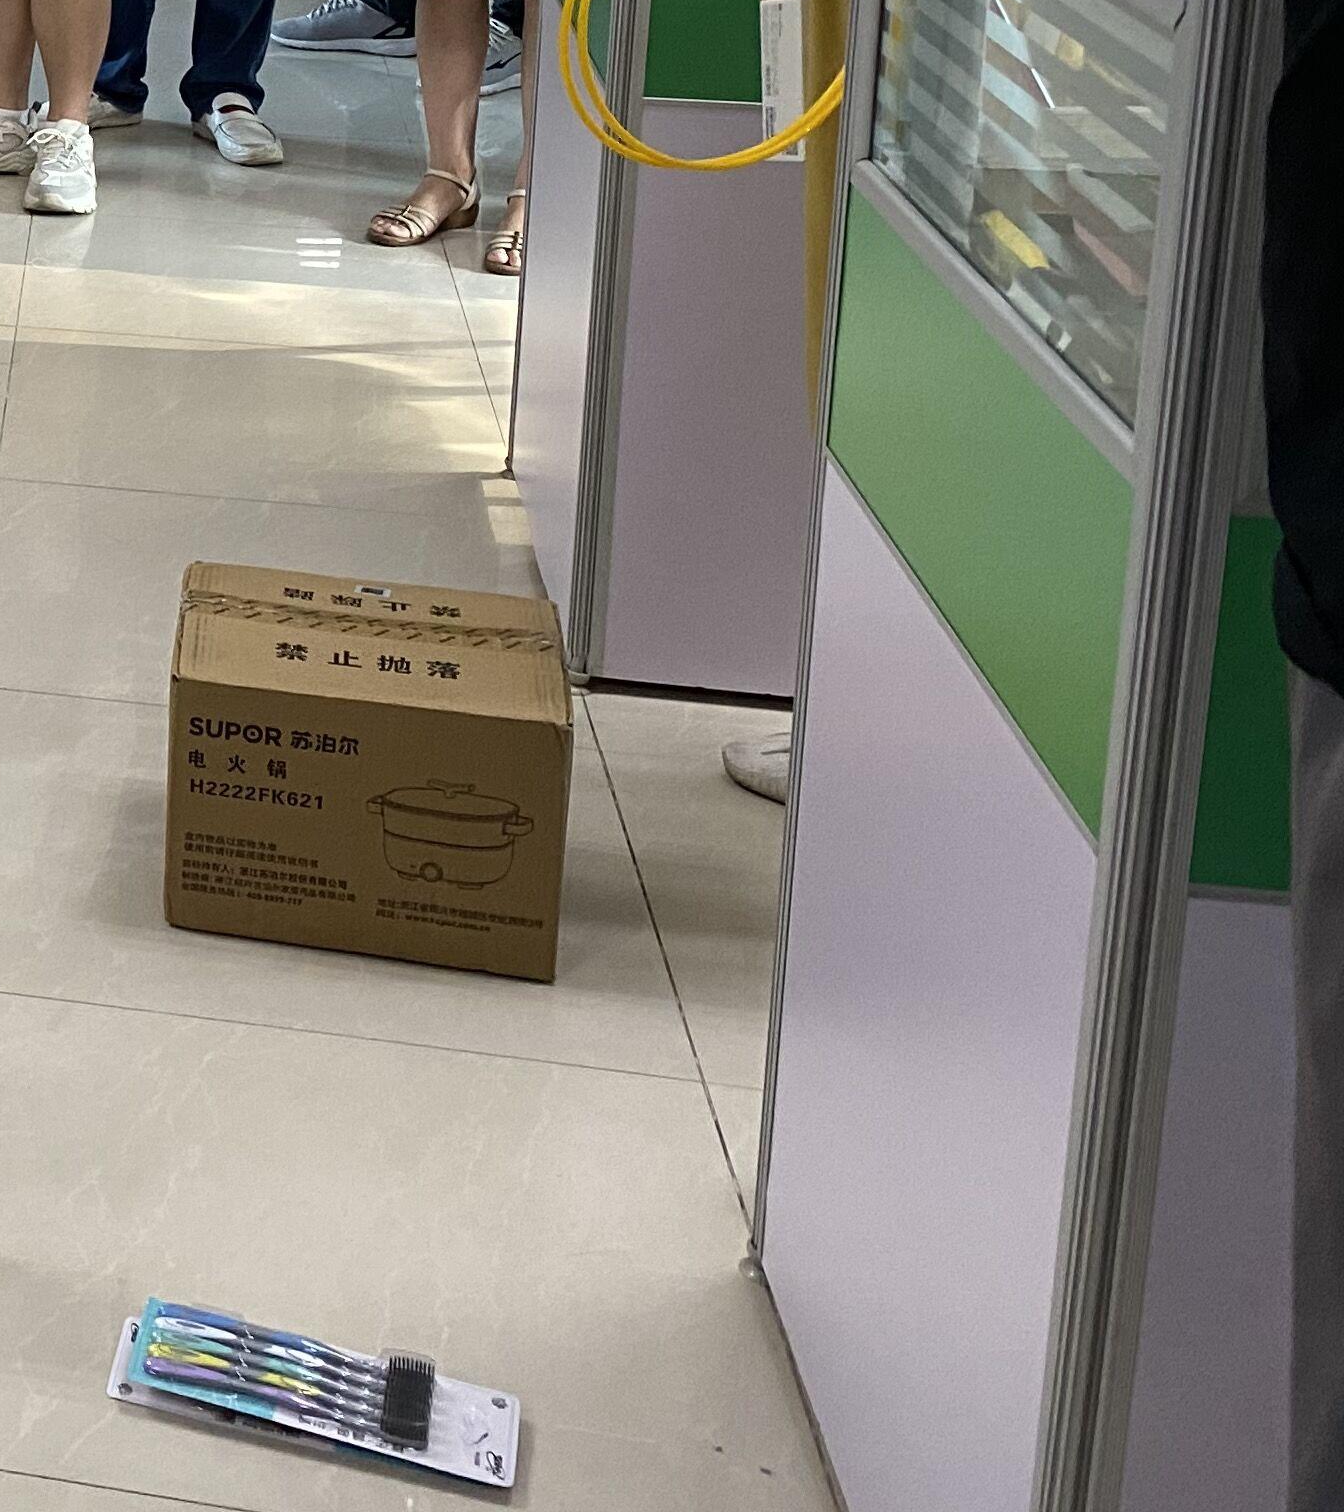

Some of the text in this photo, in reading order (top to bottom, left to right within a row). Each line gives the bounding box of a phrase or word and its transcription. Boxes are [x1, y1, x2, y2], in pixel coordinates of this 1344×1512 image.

[275, 642, 461, 679] 禁止抛落
[188, 716, 360, 756] SUPOR 苏泊尔
[187, 749, 287, 779] 电火锅
[189, 778, 324, 810] H2222FK621
